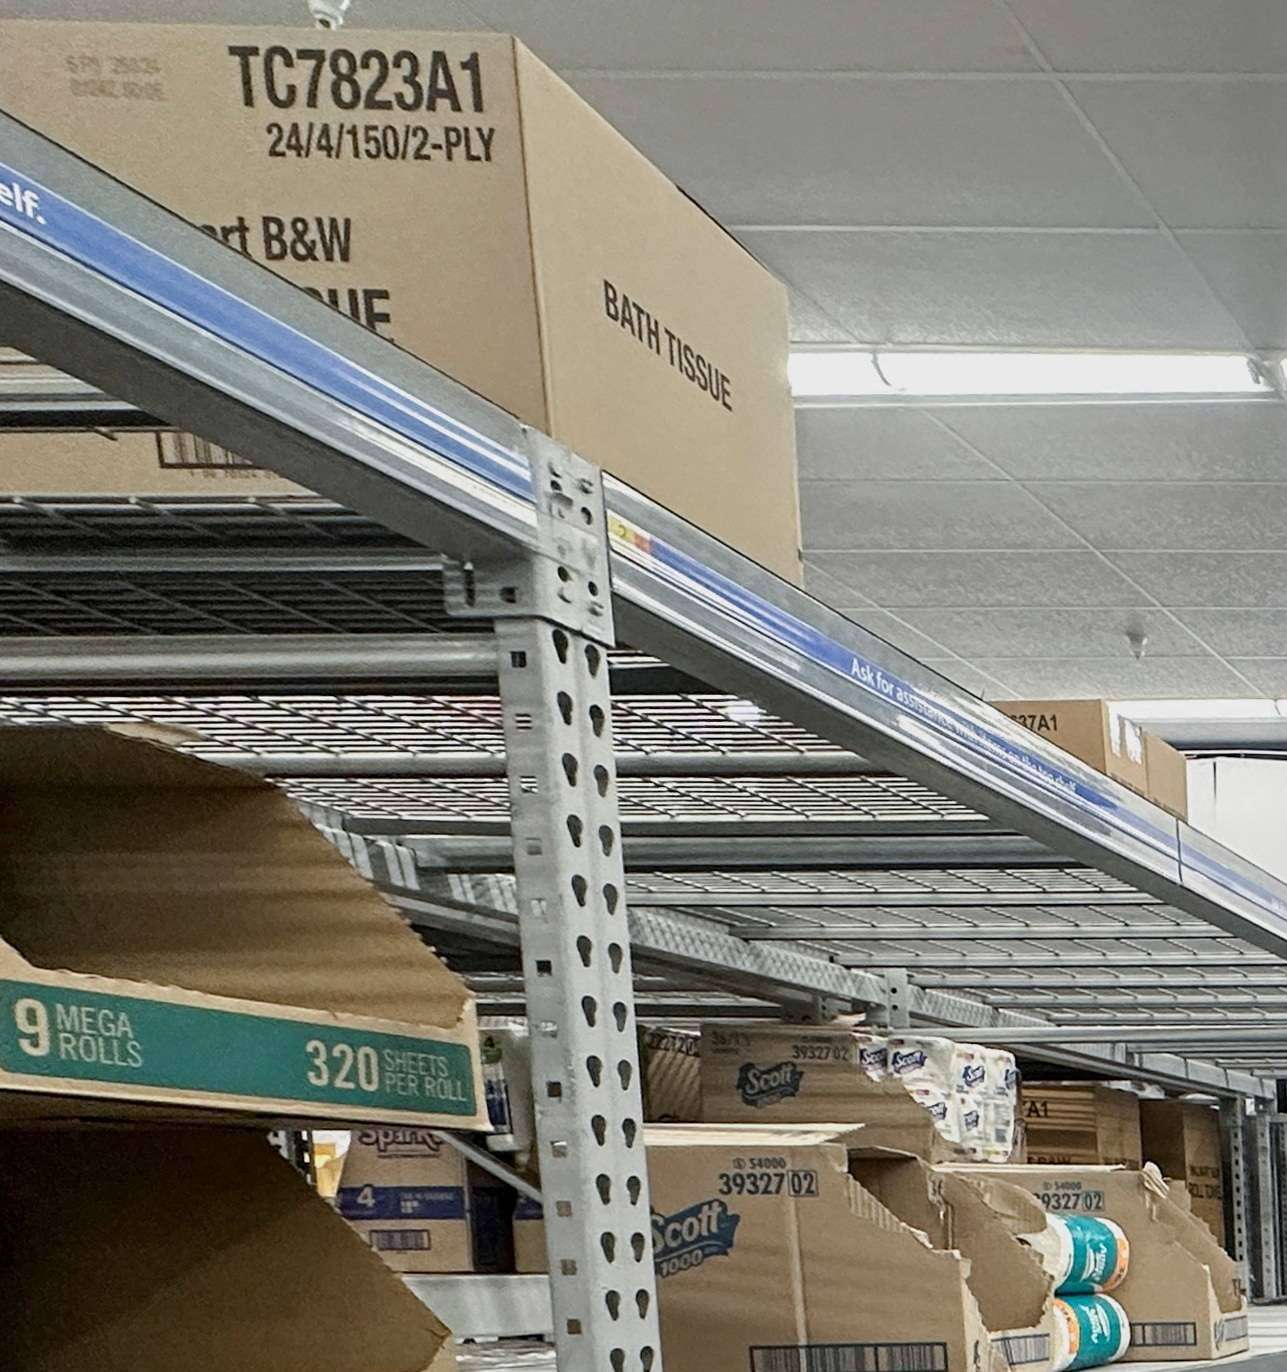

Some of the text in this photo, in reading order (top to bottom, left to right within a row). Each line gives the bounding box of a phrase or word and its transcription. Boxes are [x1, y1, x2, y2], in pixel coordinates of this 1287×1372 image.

[228, 45, 487, 113] TC7823A1
[266, 123, 496, 163] 24/4/150/2-PLY
[0, 182, 46, 224] elf.
[262, 216, 351, 262] B&W
[603, 277, 733, 412] BATH TISSUE
[851, 658, 876, 687] Ask
[876, 672, 895, 697] for
[14, 997, 134, 1057] 9 MEGA
[58, 1034, 144, 1068] ROLLS
[304, 1039, 449, 1092] 320 SHEETS
[384, 1072, 468, 1103] PER ROLL
[746, 1066, 794, 1095] Scott
[356, 1186, 375, 1207] 4
[719, 1173, 815, 1195] 39327 02
[1084, 1193, 1103, 1210] 02
[651, 1201, 722, 1254] Scott
[660, 1250, 704, 1277] 1000
